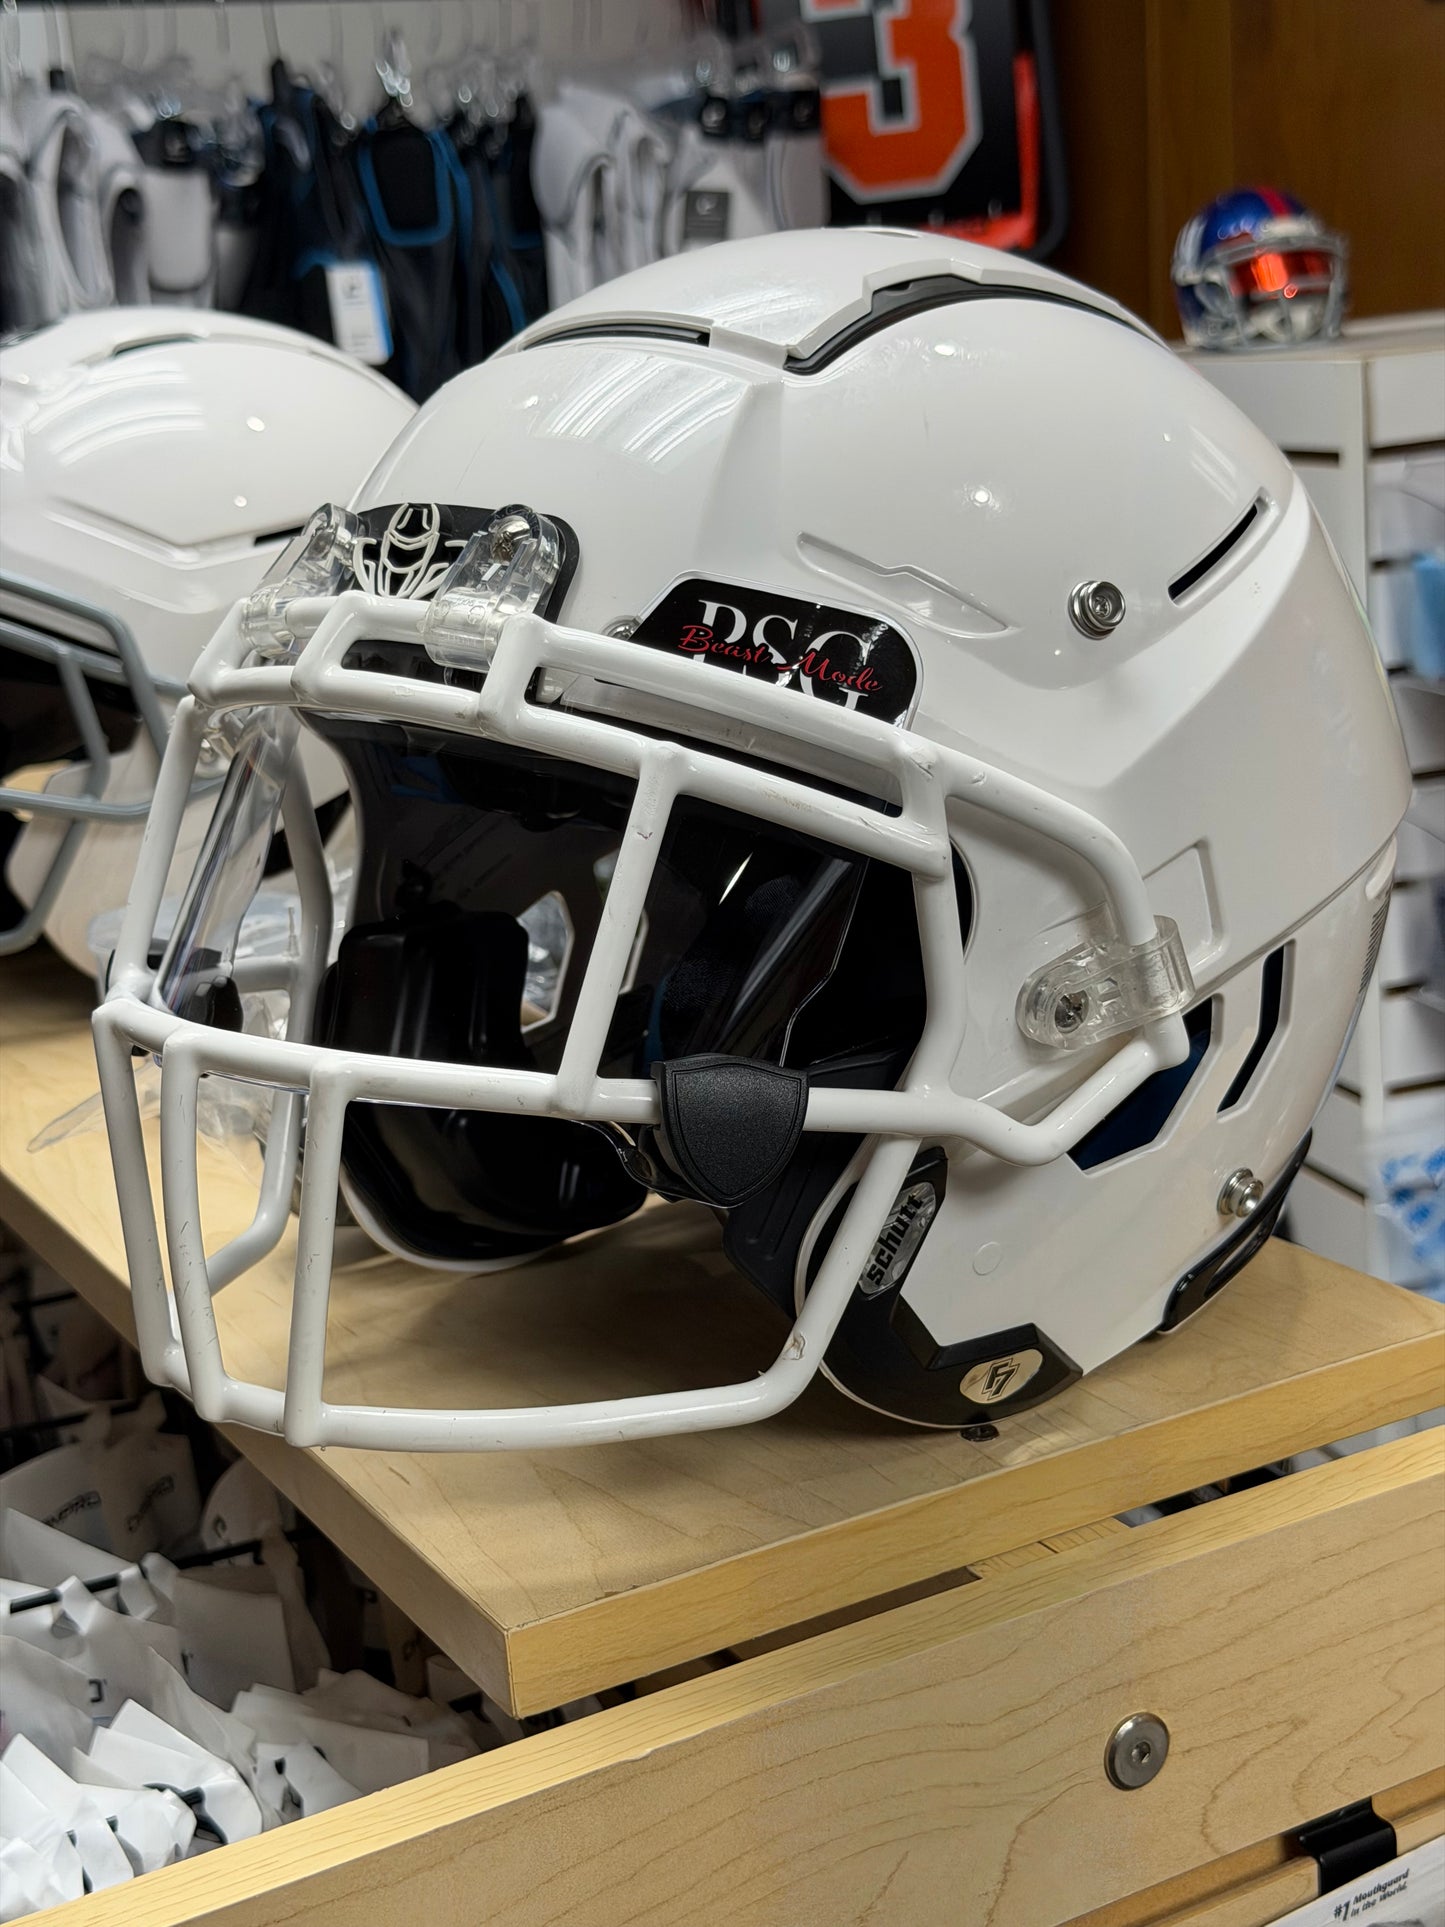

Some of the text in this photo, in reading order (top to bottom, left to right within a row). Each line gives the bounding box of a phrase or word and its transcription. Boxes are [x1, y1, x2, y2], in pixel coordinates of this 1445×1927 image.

[804, 0, 983, 205] 3
[678, 625, 883, 692] Beast Mode
[1333, 1868, 1409, 1921] #1 Mouthguard
[1351, 1907, 1359, 1917] in
[1362, 1899, 1376, 1911] the
